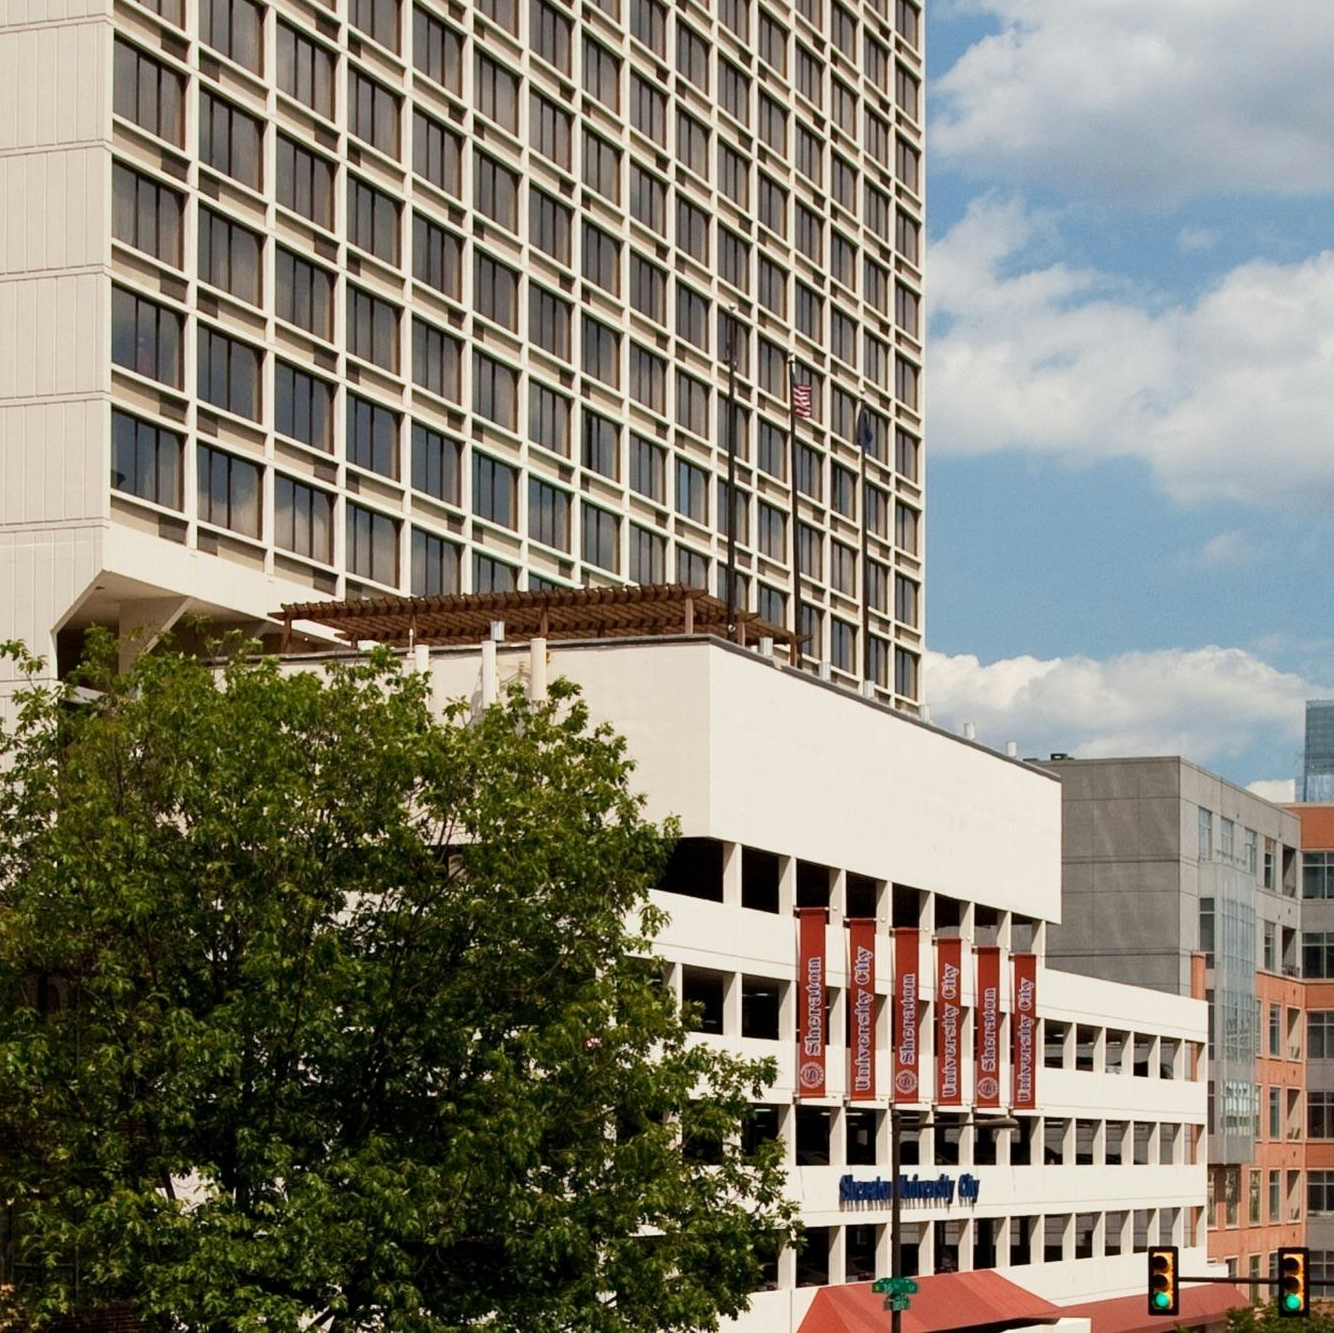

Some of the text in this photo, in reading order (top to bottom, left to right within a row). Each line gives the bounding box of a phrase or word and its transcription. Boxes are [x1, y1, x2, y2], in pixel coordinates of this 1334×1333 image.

[805, 957, 821, 1056] Sheraton
[854, 946, 873, 1091] University City
[899, 973, 915, 1065] Sheraton
[942, 963, 959, 1098] University City
[981, 987, 996, 1072] Sheraton
[1018, 977, 1035, 1102] University City
